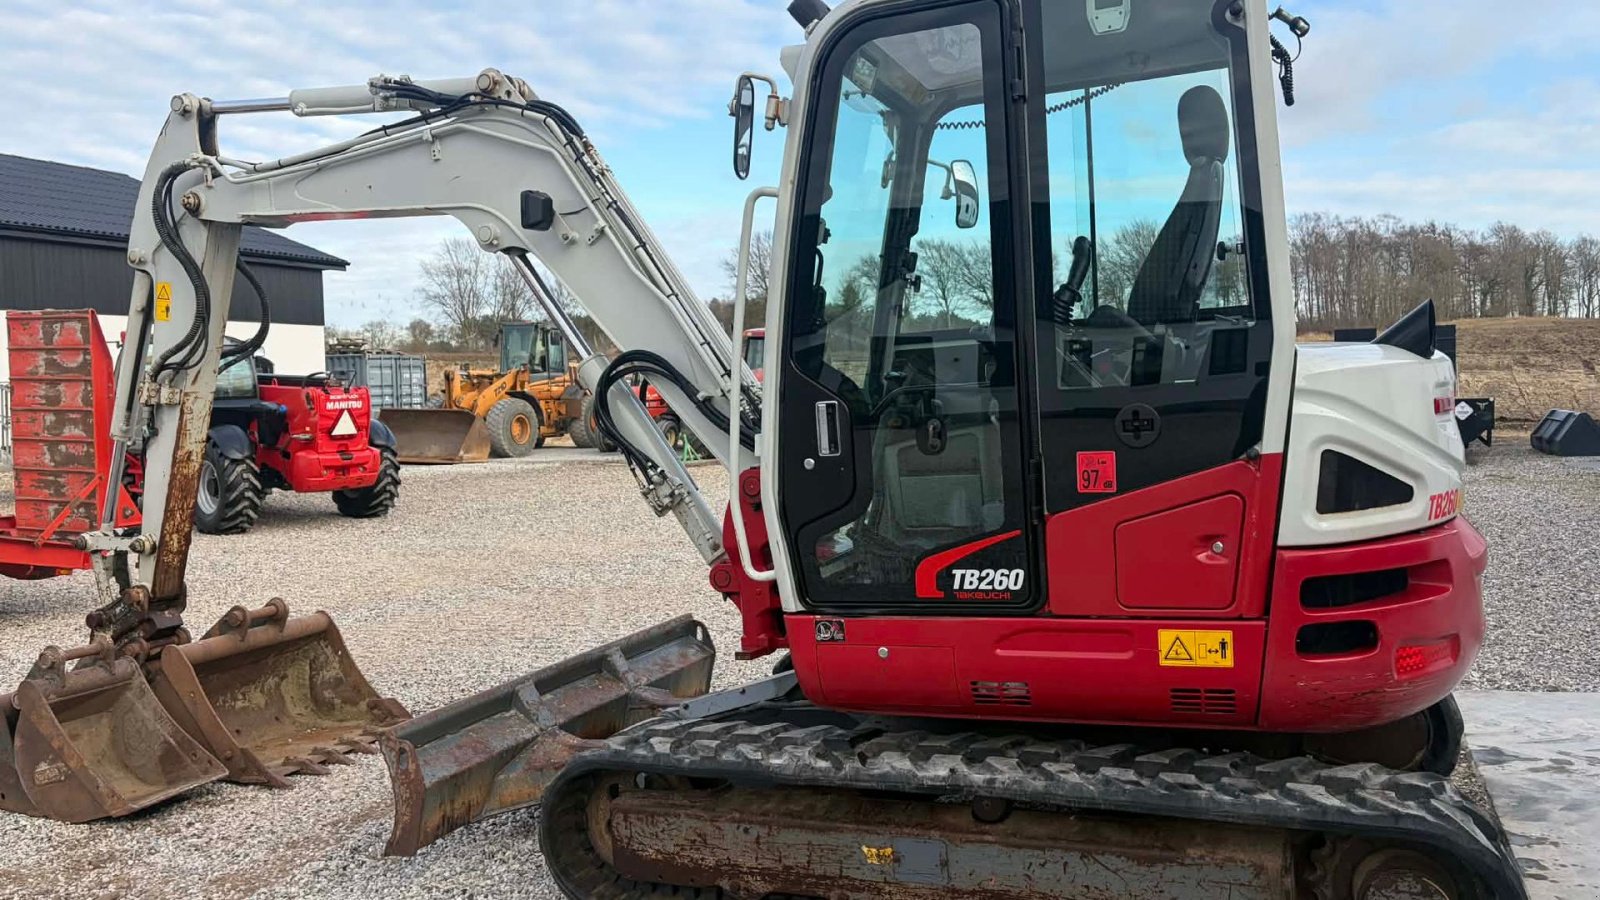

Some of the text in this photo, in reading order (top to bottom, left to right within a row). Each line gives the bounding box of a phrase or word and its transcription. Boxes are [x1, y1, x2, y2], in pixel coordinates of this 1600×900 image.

[326, 400, 363, 410] MANITOU
[1081, 469, 1113, 489] 97 dB
[951, 568, 1025, 591] TB260
